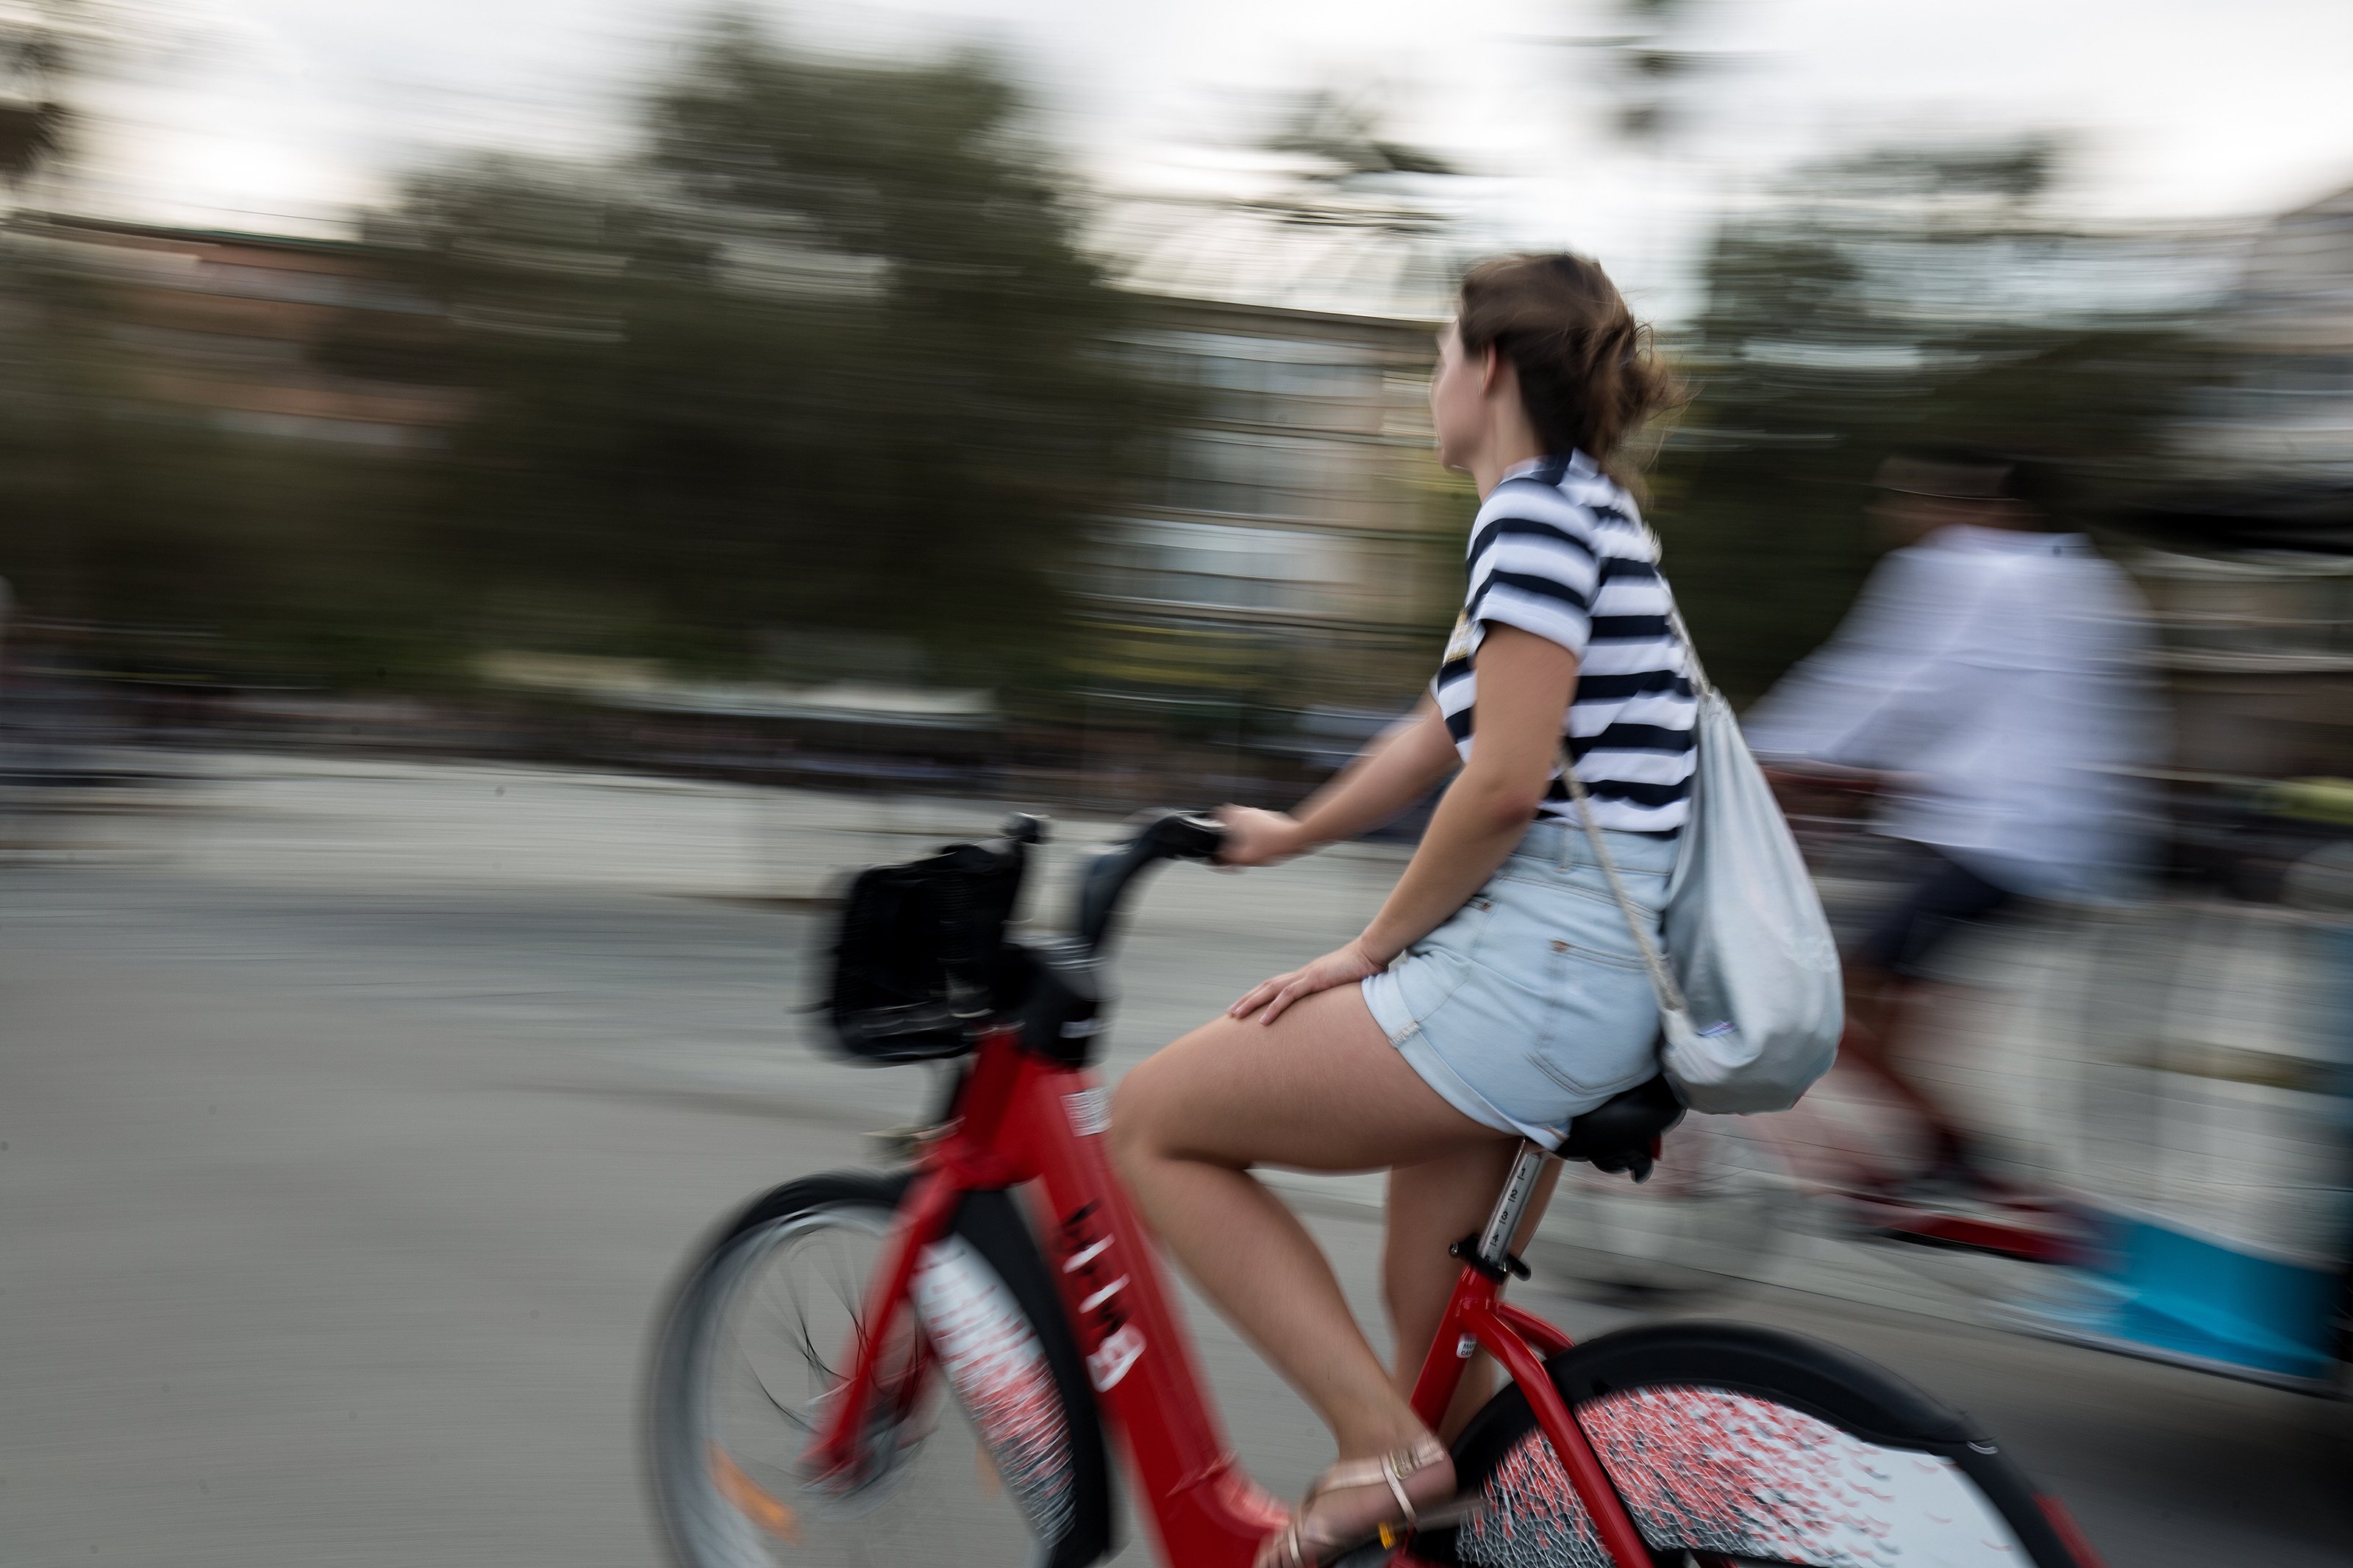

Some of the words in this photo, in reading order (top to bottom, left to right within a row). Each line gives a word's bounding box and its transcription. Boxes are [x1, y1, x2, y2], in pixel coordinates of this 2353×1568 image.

[1521, 1168, 1527, 1176] 1
[1510, 1189, 1518, 1199] 2
[1501, 1211, 1508, 1220] 3
[1492, 1234, 1499, 1243] 4
[1484, 1255, 1491, 1263] 5
